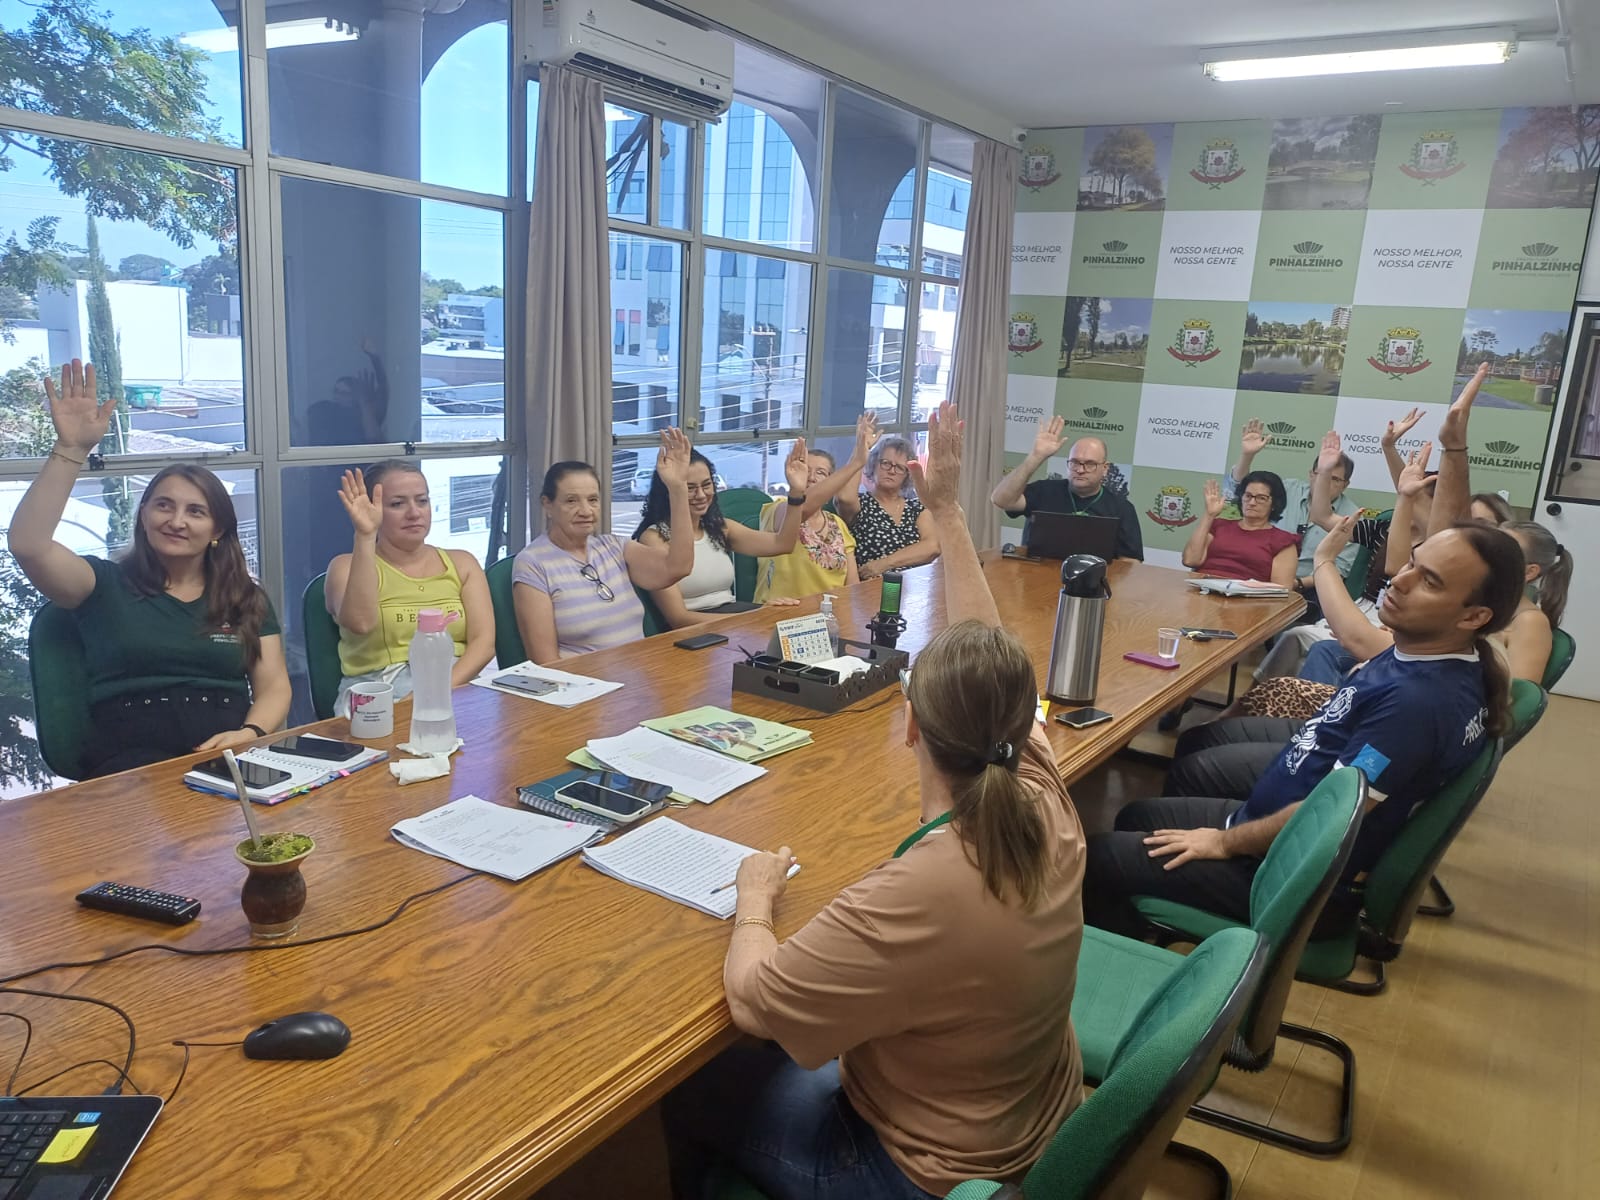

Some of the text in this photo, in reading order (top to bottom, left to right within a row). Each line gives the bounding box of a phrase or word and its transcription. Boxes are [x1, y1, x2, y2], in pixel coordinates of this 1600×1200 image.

[1170, 246, 1244, 255] NOSSO MELHOR,
[1373, 248, 1462, 258] NOSSO MELHOR,
[1030, 255, 1056, 263] GENTE
[1082, 256, 1145, 264] PINHALZINHO
[1174, 256, 1237, 265] NOSSA GENTE
[1269, 258, 1343, 267] PINHALZINHO
[1378, 260, 1454, 268] NOSSA GENTE
[1492, 261, 1581, 271] PINHALZINHO
[1013, 415, 1039, 423] GENTE
[1148, 417, 1220, 430] NOSSO MELHOR,
[1064, 420, 1124, 431] PINHALZINHO
[1152, 427, 1214, 439] NOSSA GENTE
[1262, 437, 1315, 448] ALZINHO
[1343, 433, 1380, 443] NOSSO
[1349, 445, 1383, 454] NOSSA
